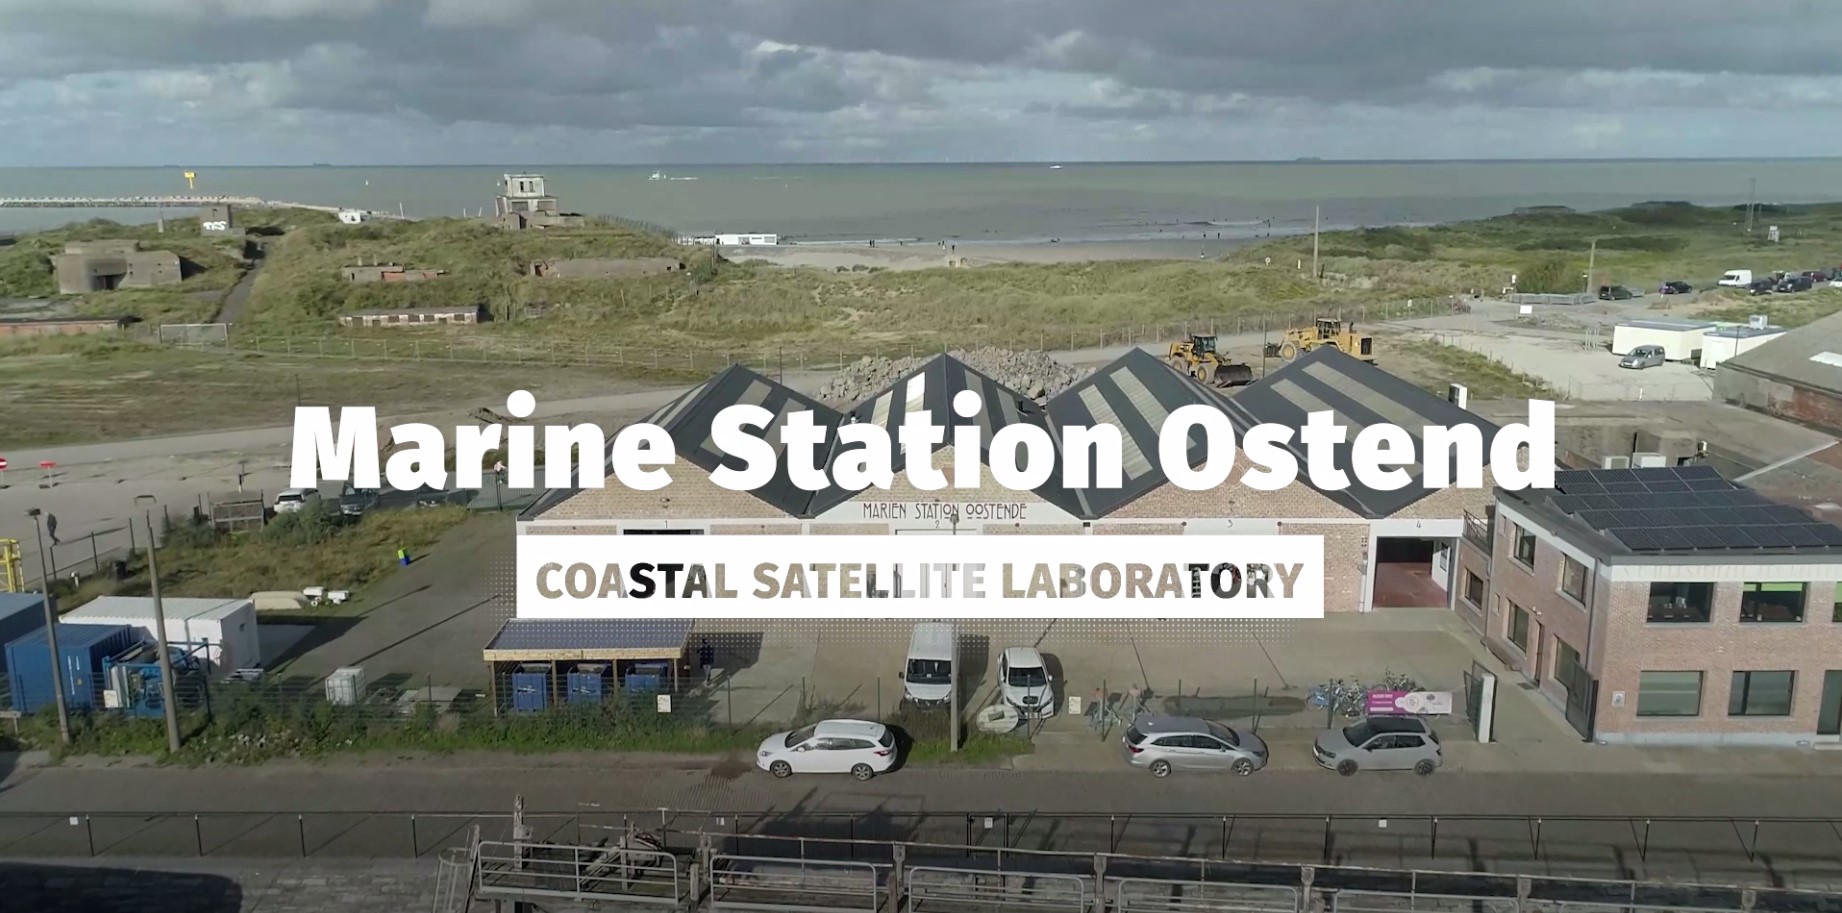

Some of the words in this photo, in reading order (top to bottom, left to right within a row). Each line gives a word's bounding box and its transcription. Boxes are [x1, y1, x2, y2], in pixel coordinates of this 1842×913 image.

[863, 503, 907, 519] MARIEN
[914, 503, 960, 519] STATION
[966, 503, 1027, 519] OOSTENDE
